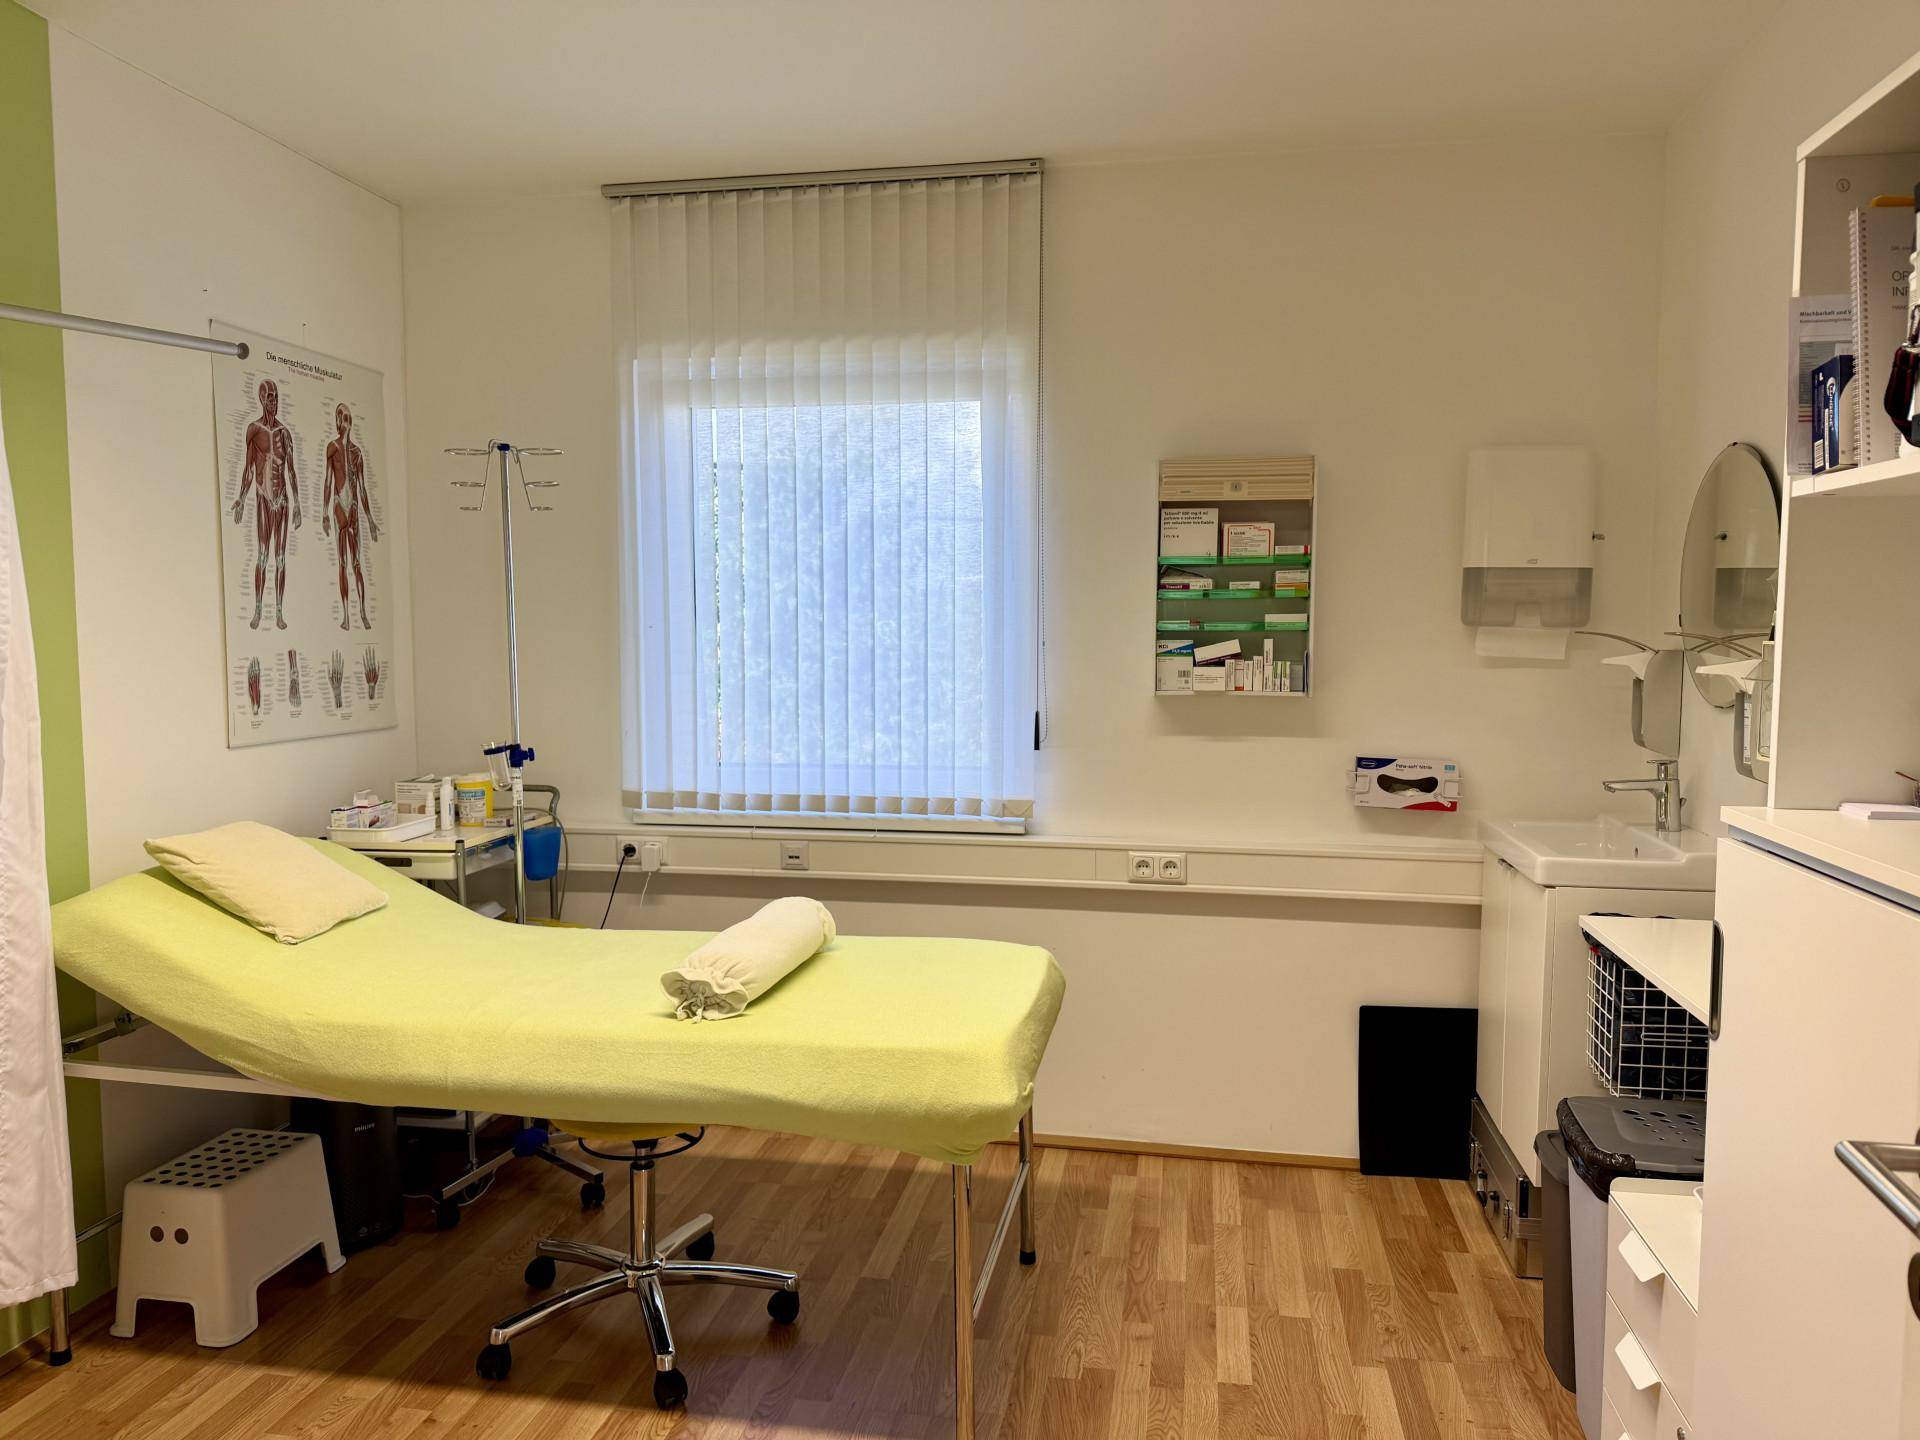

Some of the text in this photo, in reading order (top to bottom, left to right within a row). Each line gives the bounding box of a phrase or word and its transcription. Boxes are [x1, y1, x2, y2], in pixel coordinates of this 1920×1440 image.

[266, 351, 343, 381] Die menschliche Muskulatur
